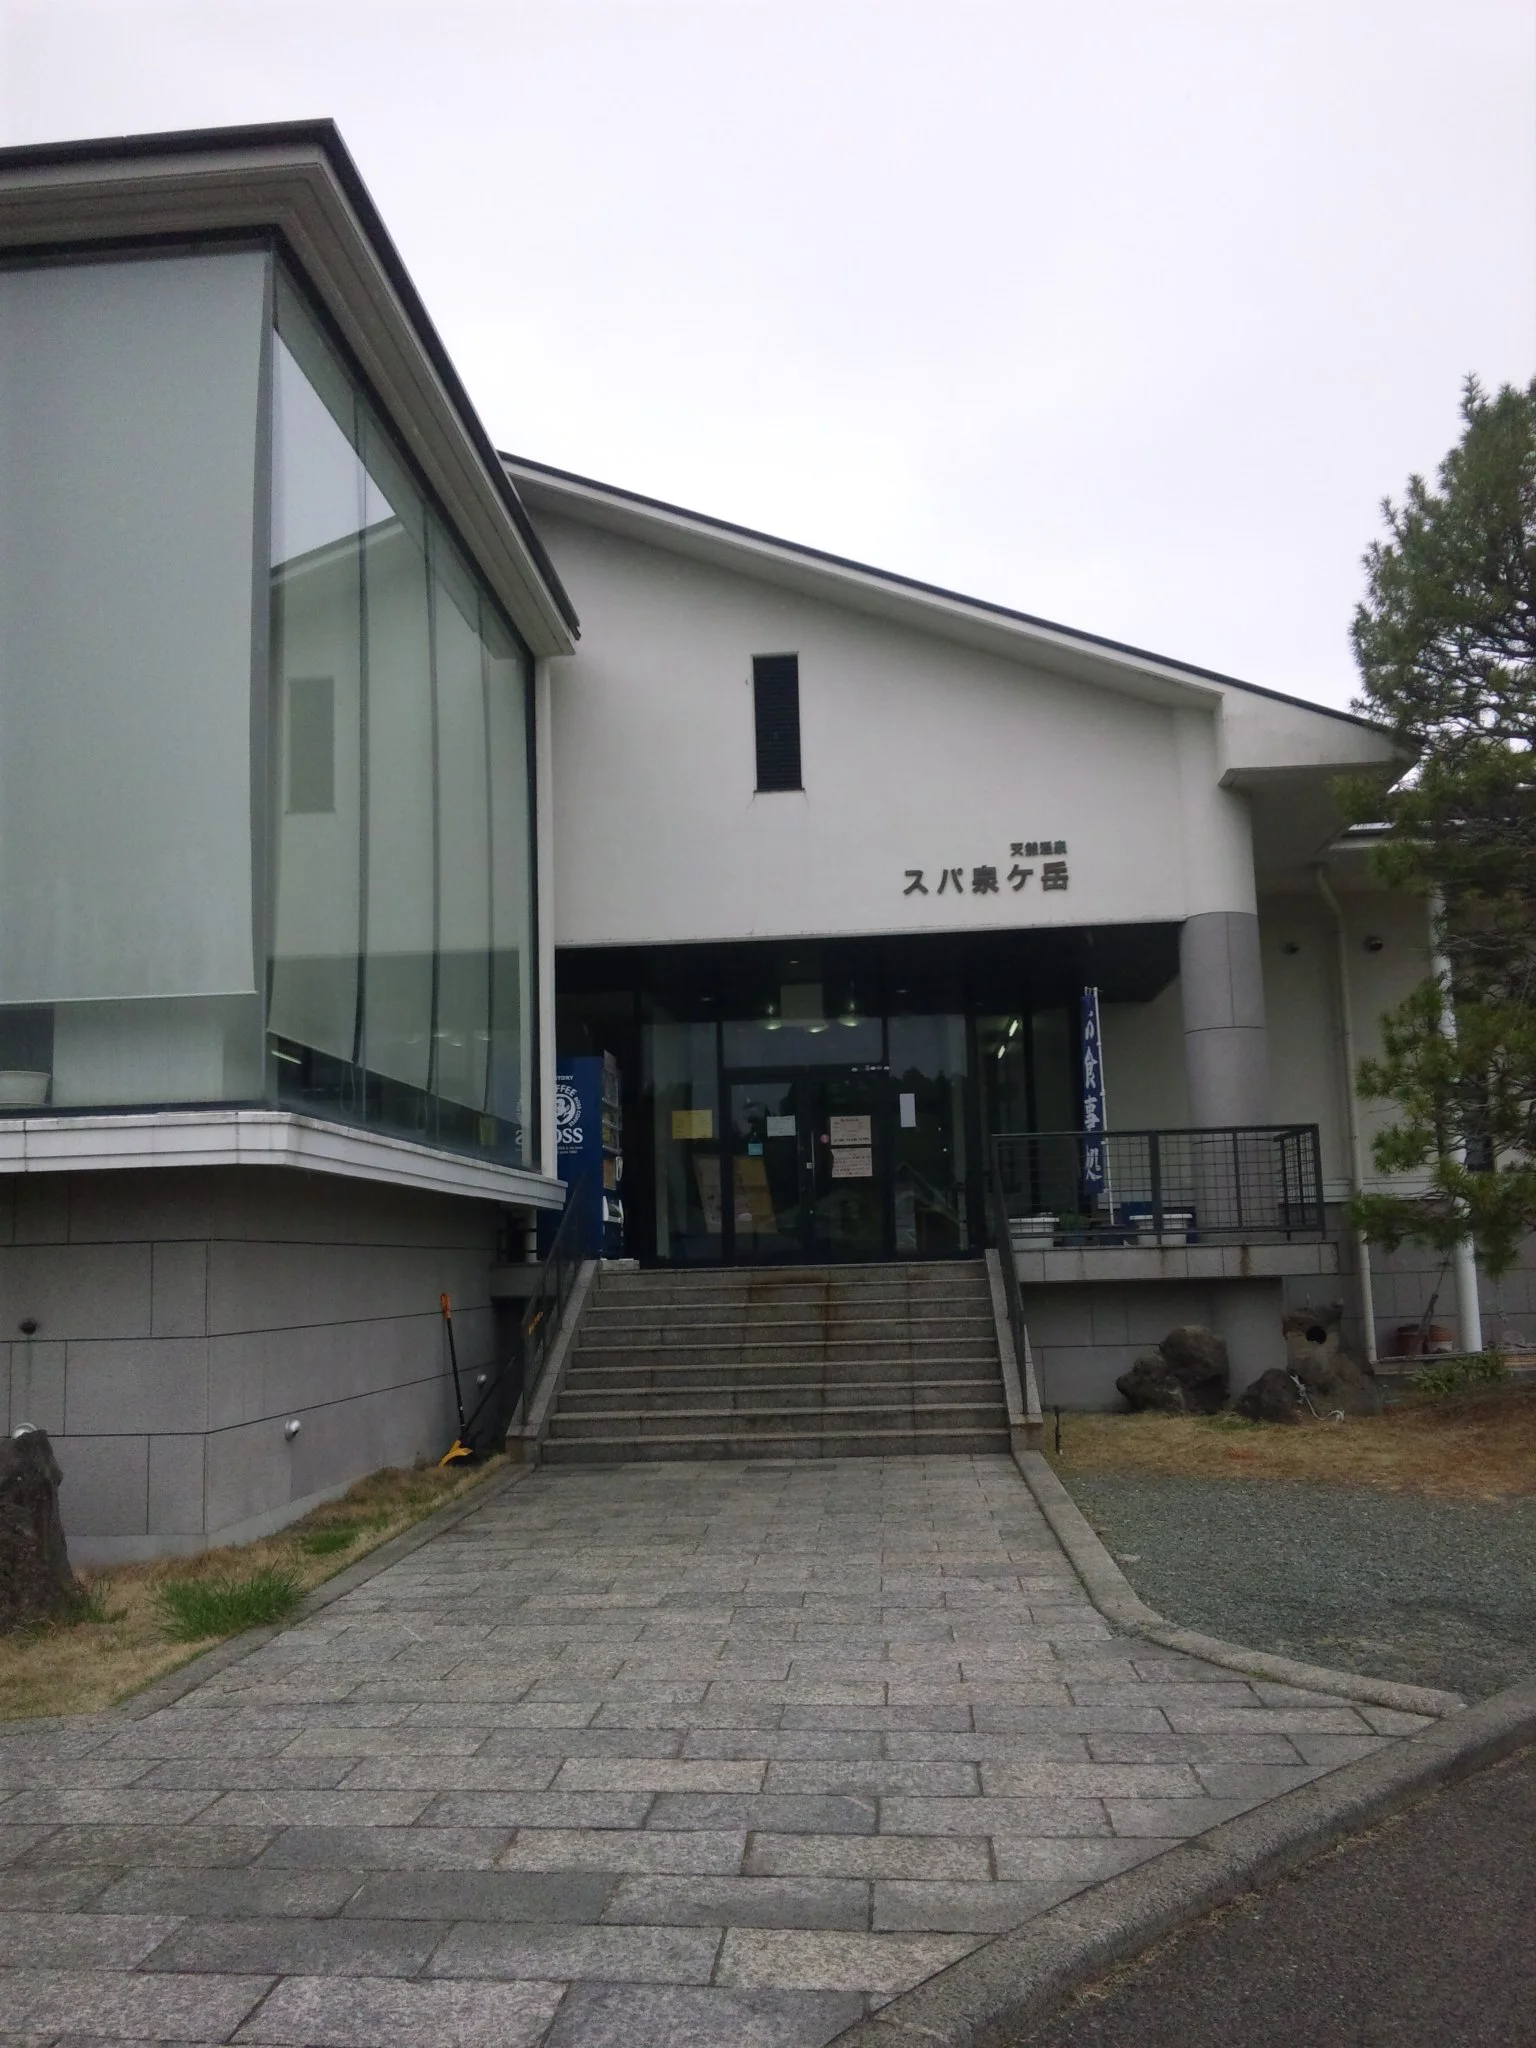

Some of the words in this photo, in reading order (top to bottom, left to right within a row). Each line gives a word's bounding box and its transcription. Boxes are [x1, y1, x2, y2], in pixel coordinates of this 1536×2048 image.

[903, 860, 1069, 896] スパ泉ケ岳
